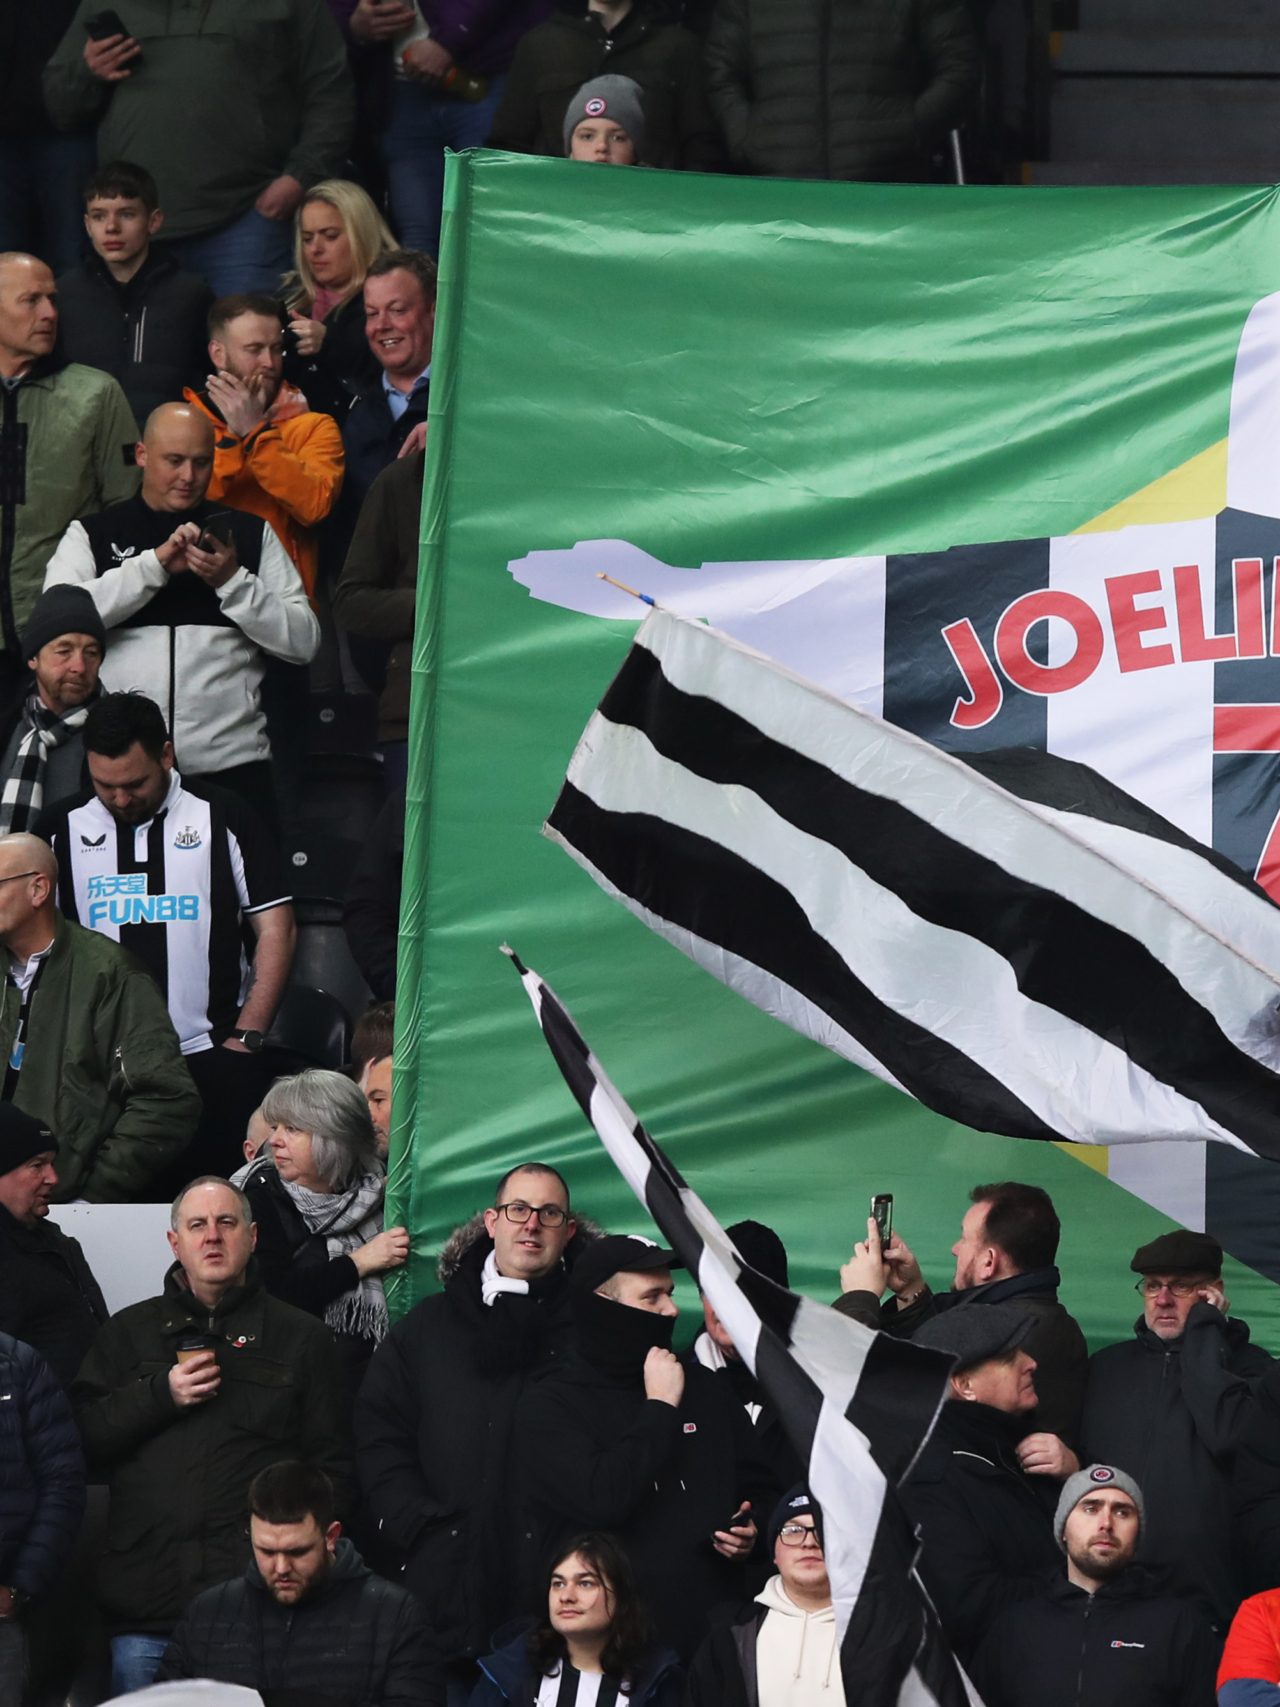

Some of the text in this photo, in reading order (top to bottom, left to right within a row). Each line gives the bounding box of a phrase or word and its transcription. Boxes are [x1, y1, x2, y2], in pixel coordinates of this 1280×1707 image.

[87, 874, 146, 899] 乐天堂
[88, 895, 199, 929] FUN88
